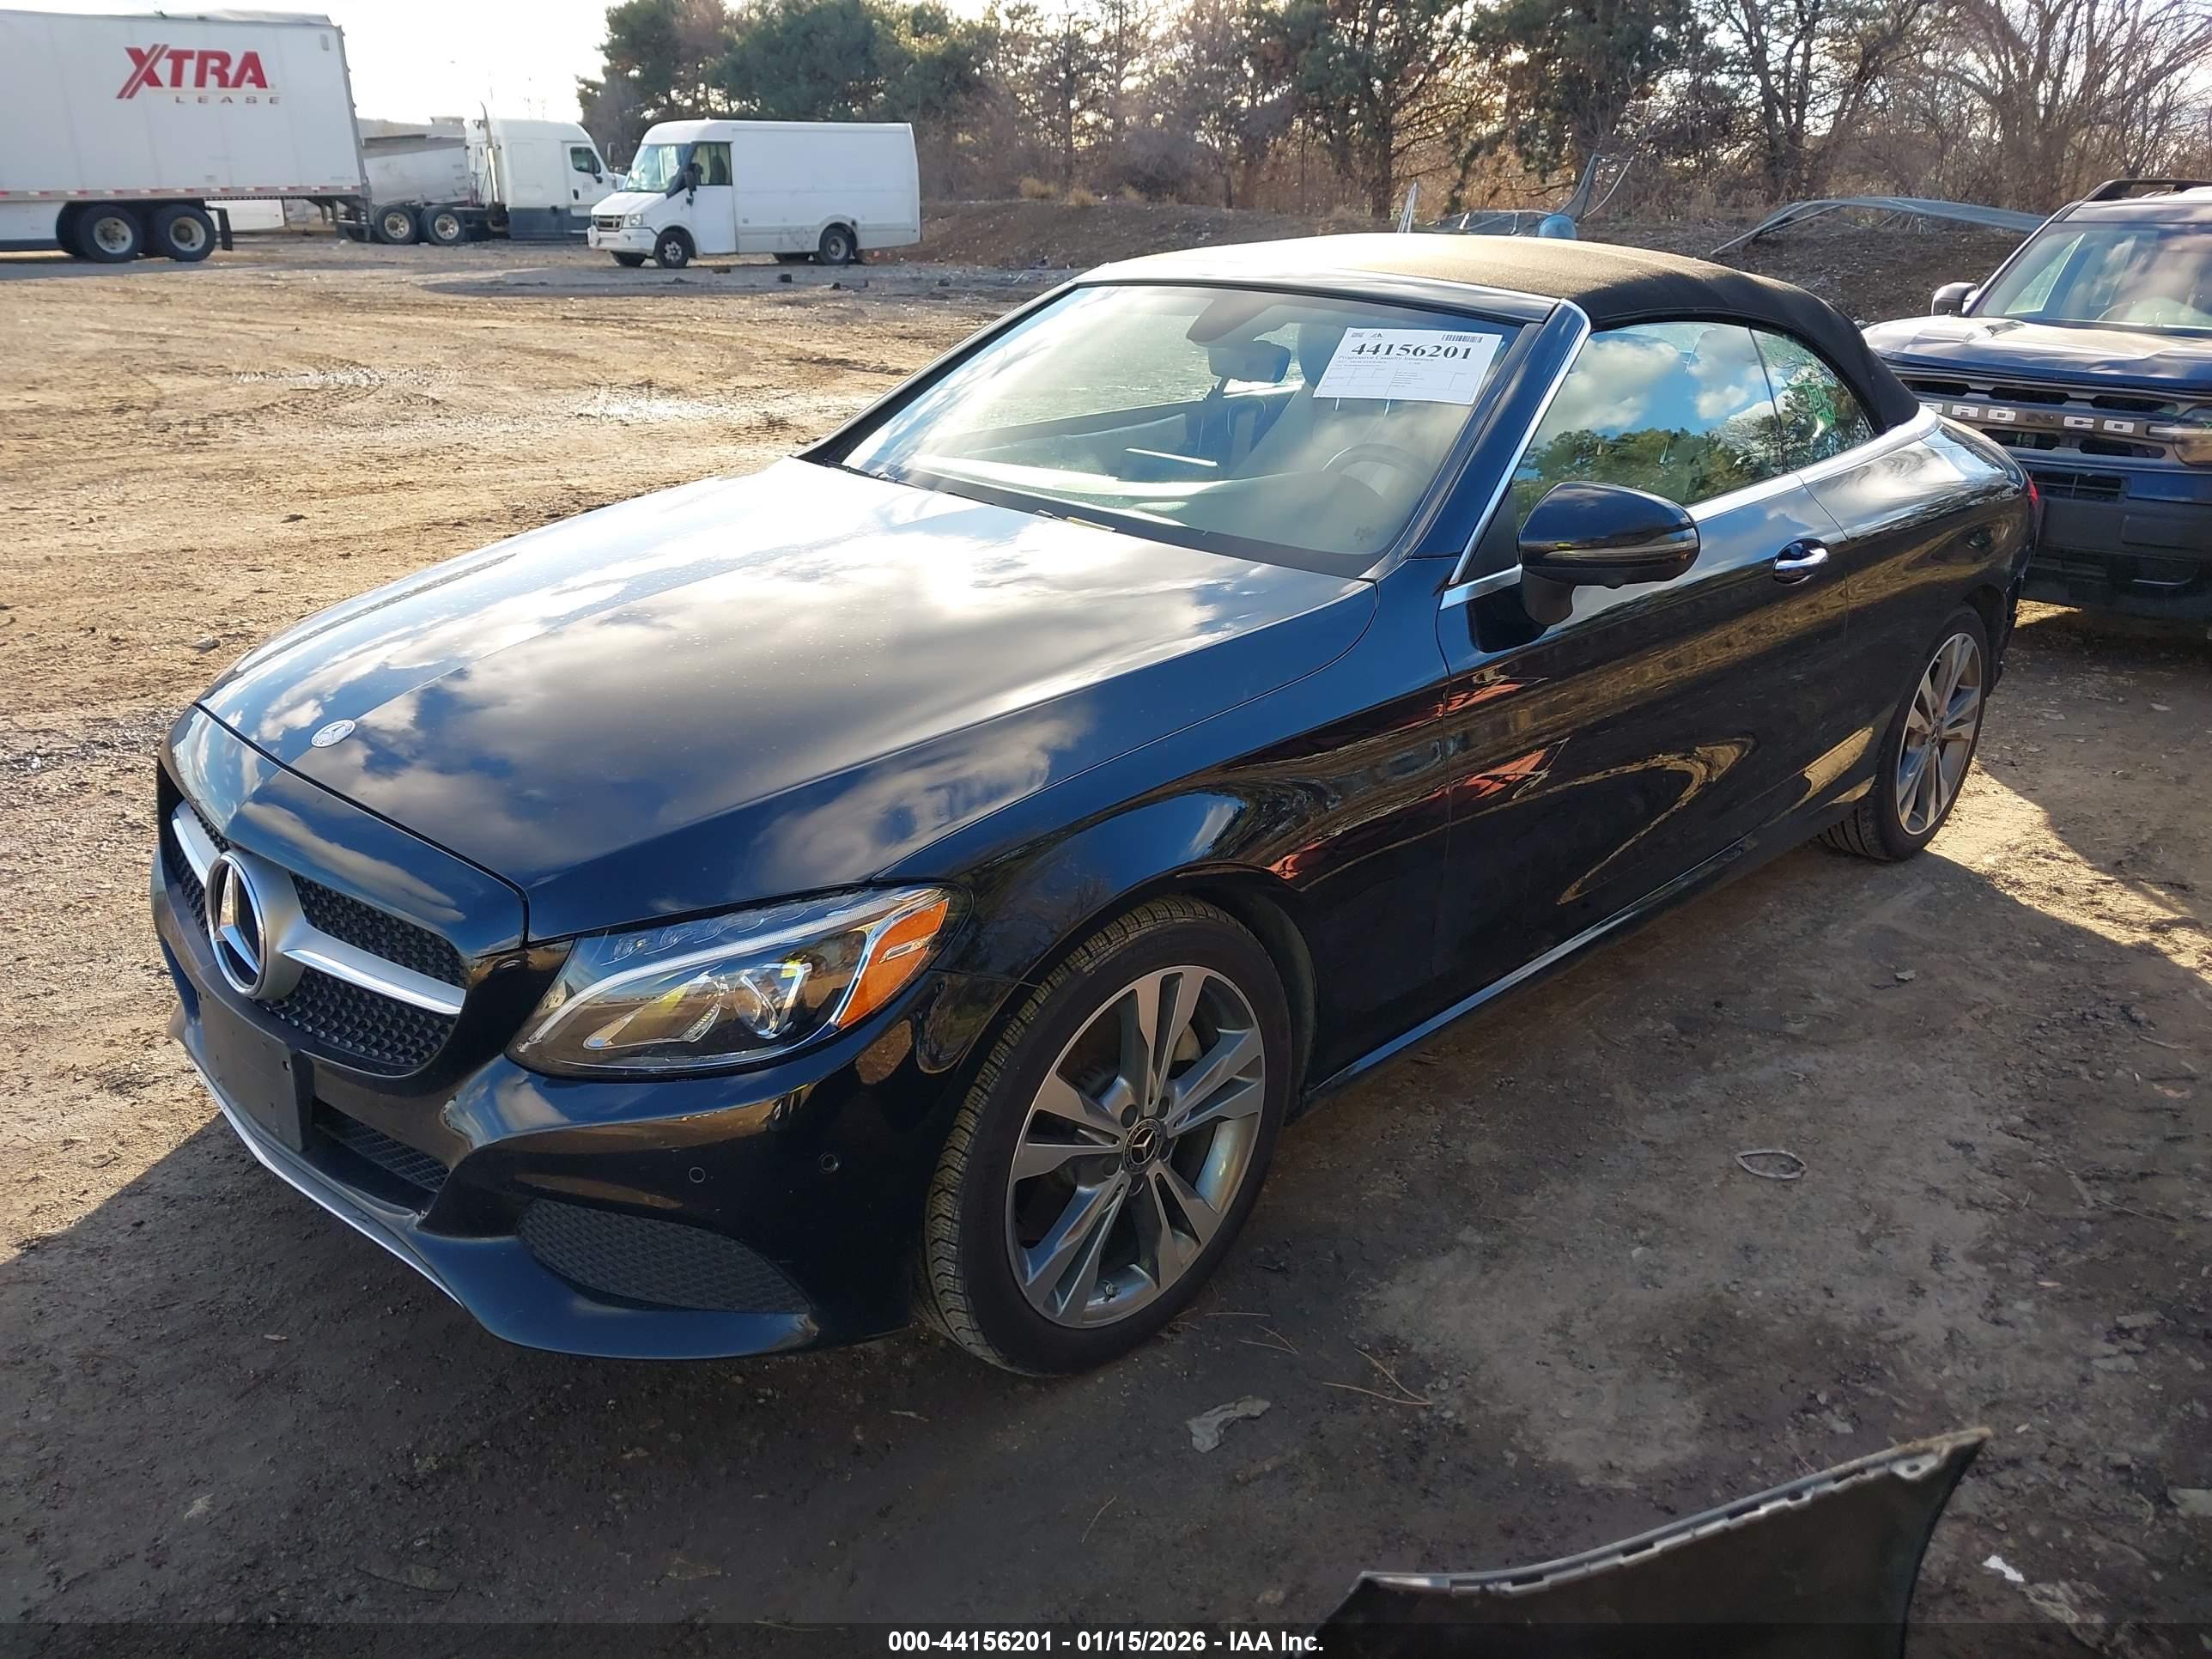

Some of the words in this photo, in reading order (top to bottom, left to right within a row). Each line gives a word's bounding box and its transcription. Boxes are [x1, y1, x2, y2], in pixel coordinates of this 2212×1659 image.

[116, 44, 268, 99] XTRA
[175, 95, 281, 105] LEASE
[1351, 342, 1472, 360] 44156201
